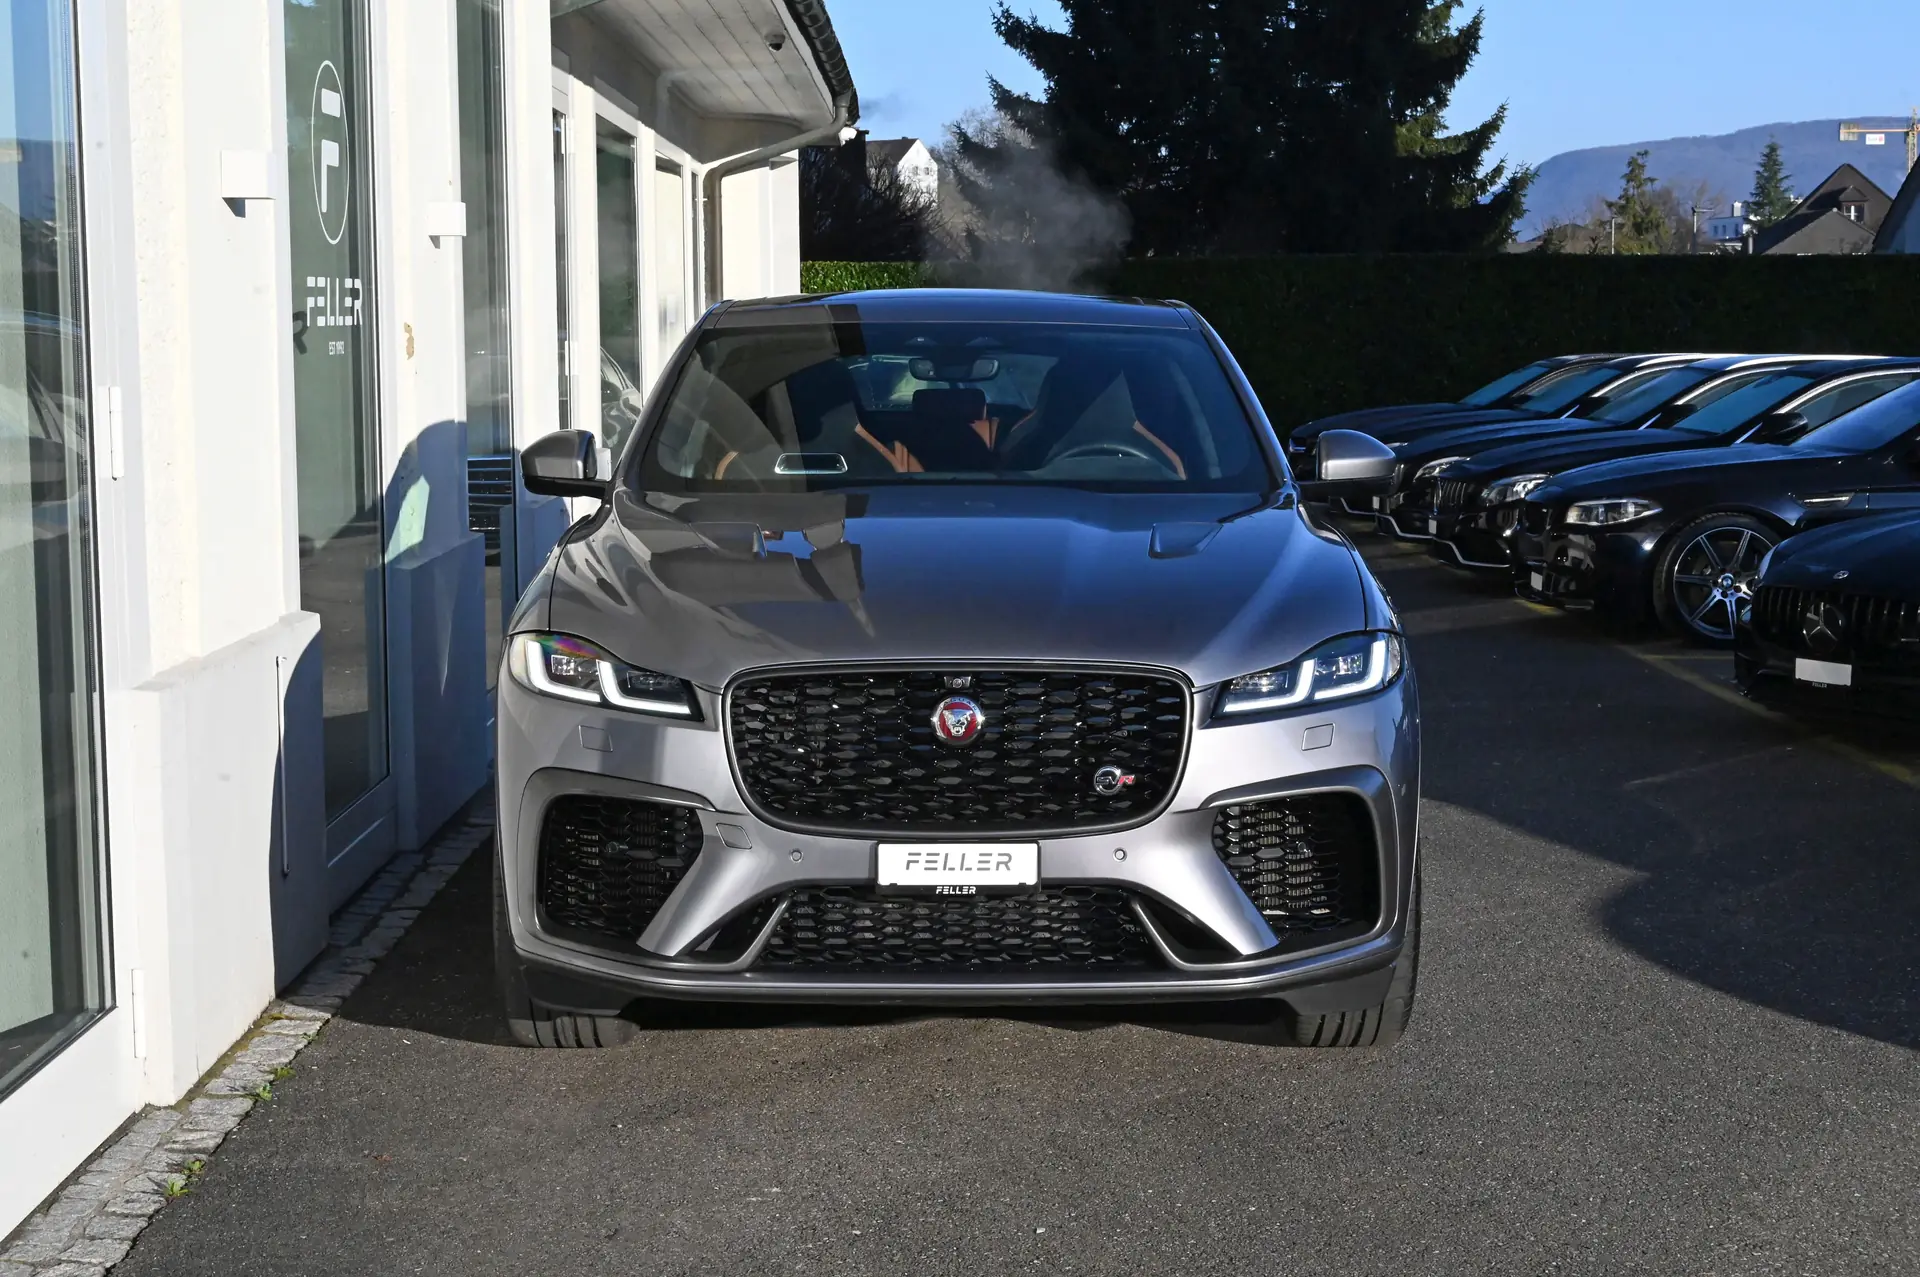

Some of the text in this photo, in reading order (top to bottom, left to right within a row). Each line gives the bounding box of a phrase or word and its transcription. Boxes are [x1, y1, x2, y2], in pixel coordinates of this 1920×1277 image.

[306, 276, 363, 327] FELLER
[905, 852, 1013, 872] FELLER
[935, 885, 977, 895] FELLER
